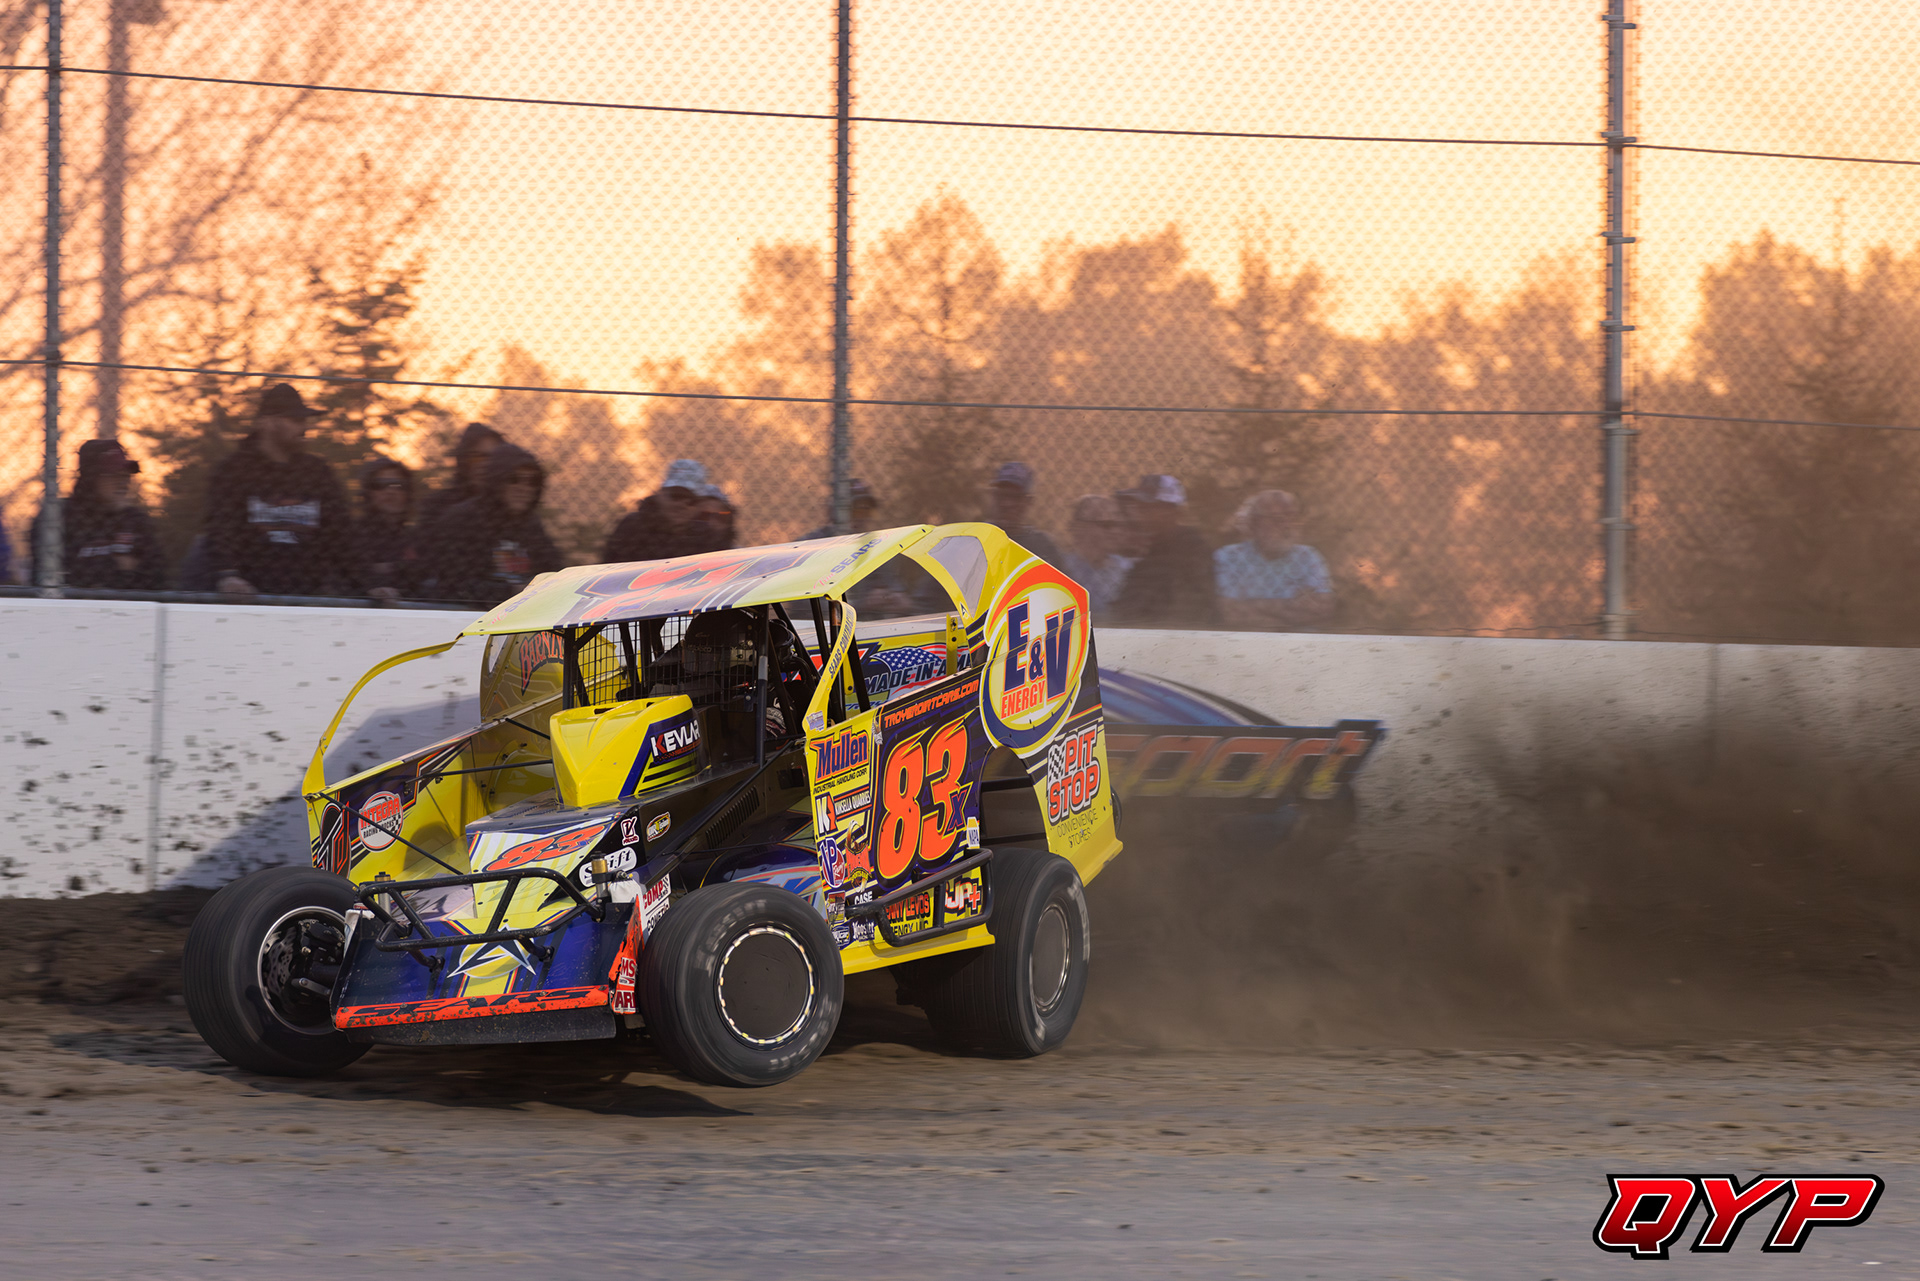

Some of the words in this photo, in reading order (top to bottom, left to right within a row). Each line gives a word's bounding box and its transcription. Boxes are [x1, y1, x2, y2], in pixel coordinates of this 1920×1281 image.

[831, 538, 882, 574] SEARS
[828, 648, 843, 679] SEARS
[1003, 599, 1077, 702] E&V
[864, 668, 914, 696] MADE
[914, 660, 936, 682] IN
[1001, 680, 1046, 720] ENERGY
[650, 719, 701, 757] KEVLAR
[1064, 729, 1097, 773] PIT
[811, 730, 869, 780] Mullen
[813, 781, 836, 795] INDUSTRIAL
[1049, 767, 1099, 820] STOP
[359, 797, 401, 829] INTEGRA
[1057, 808, 1098, 838] CONVENIENCE
[363, 827, 379, 839] RACING
[968, 829, 979, 846] NAPA
[1068, 827, 1092, 849] STORES
[584, 849, 633, 880] Sift
[820, 838, 838, 886] VP
[642, 880, 664, 909] COMP
[854, 891, 873, 906] CASE
[891, 922, 914, 935] ENCY
[620, 959, 636, 978] MS
[349, 988, 592, 1022] SEARS
